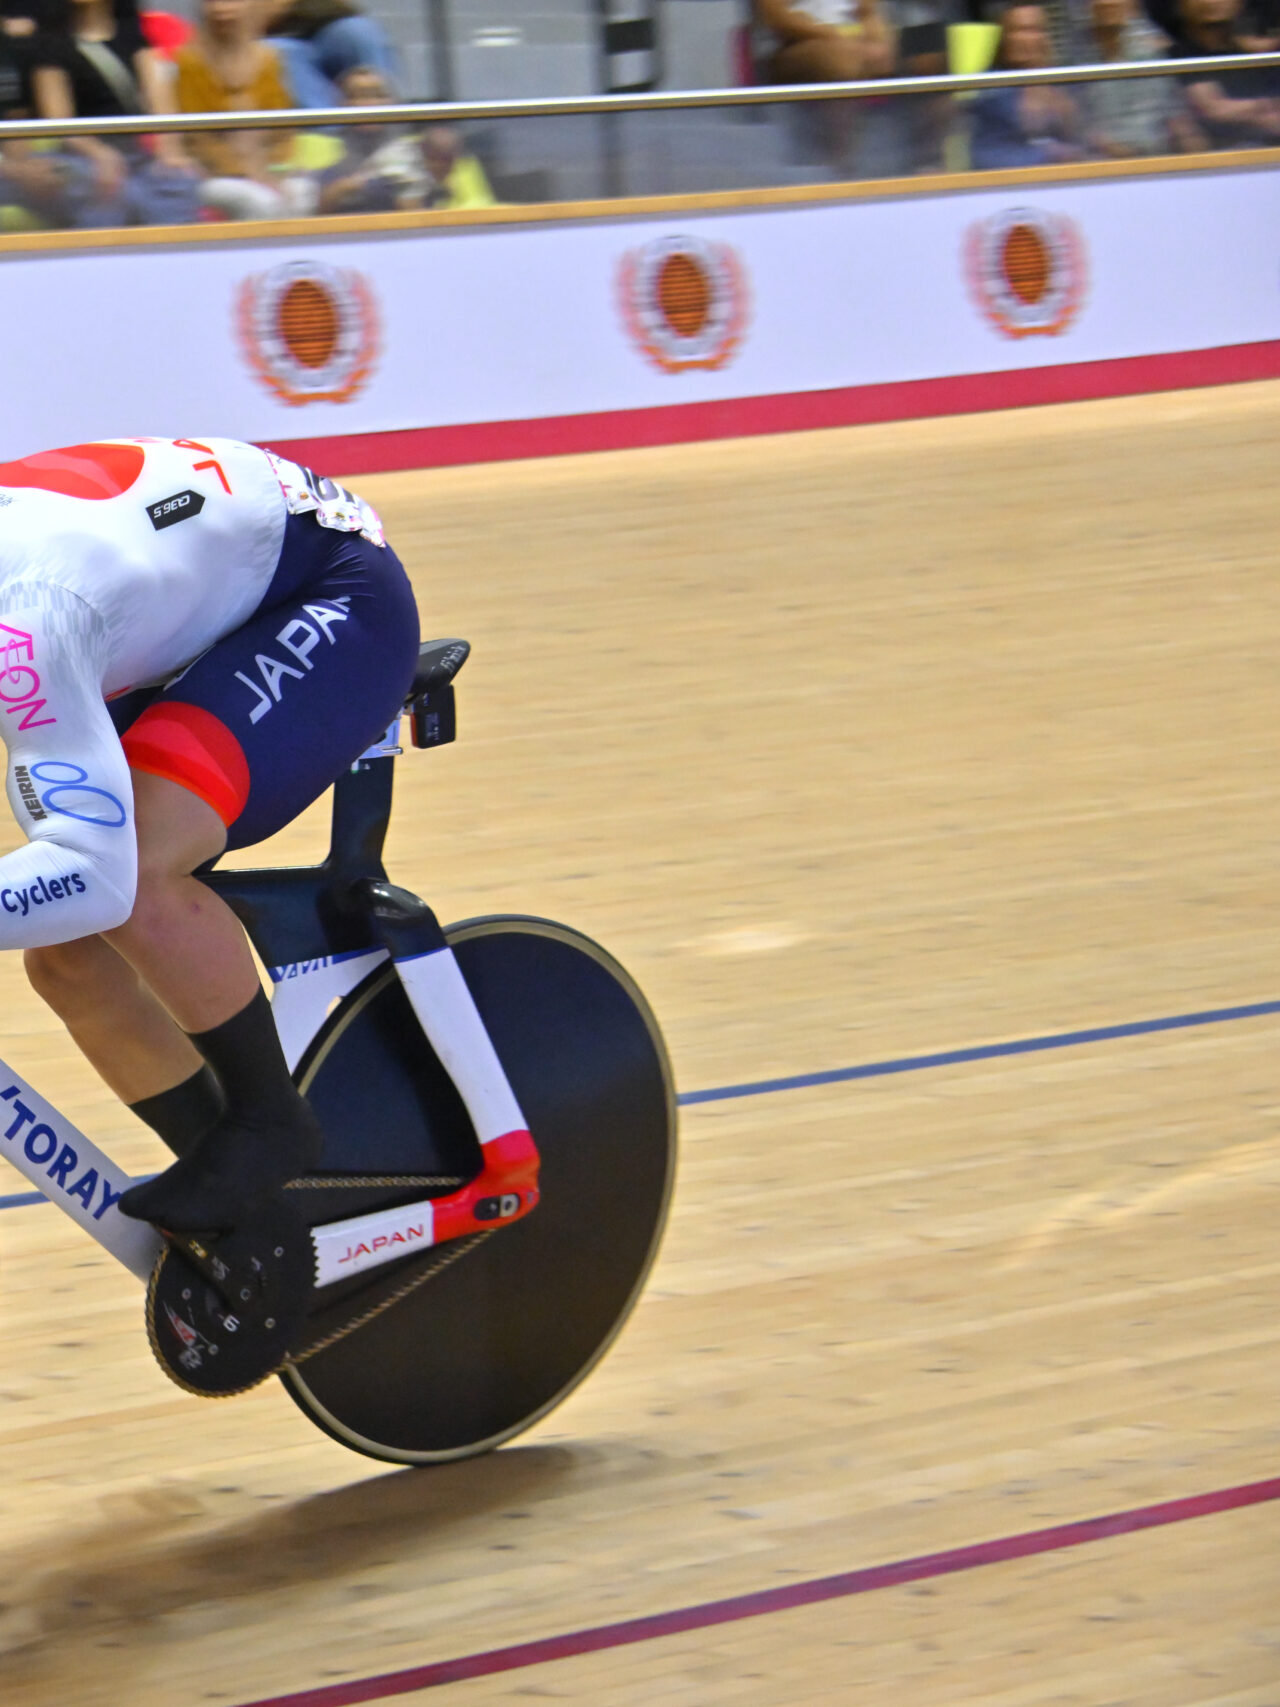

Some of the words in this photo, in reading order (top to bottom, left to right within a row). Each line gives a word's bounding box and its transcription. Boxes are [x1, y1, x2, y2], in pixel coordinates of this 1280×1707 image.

[14, 765, 48, 821] KEIRIN
[0, 872, 87, 916] Cyclers
[338, 1224, 424, 1263] JAPAN
